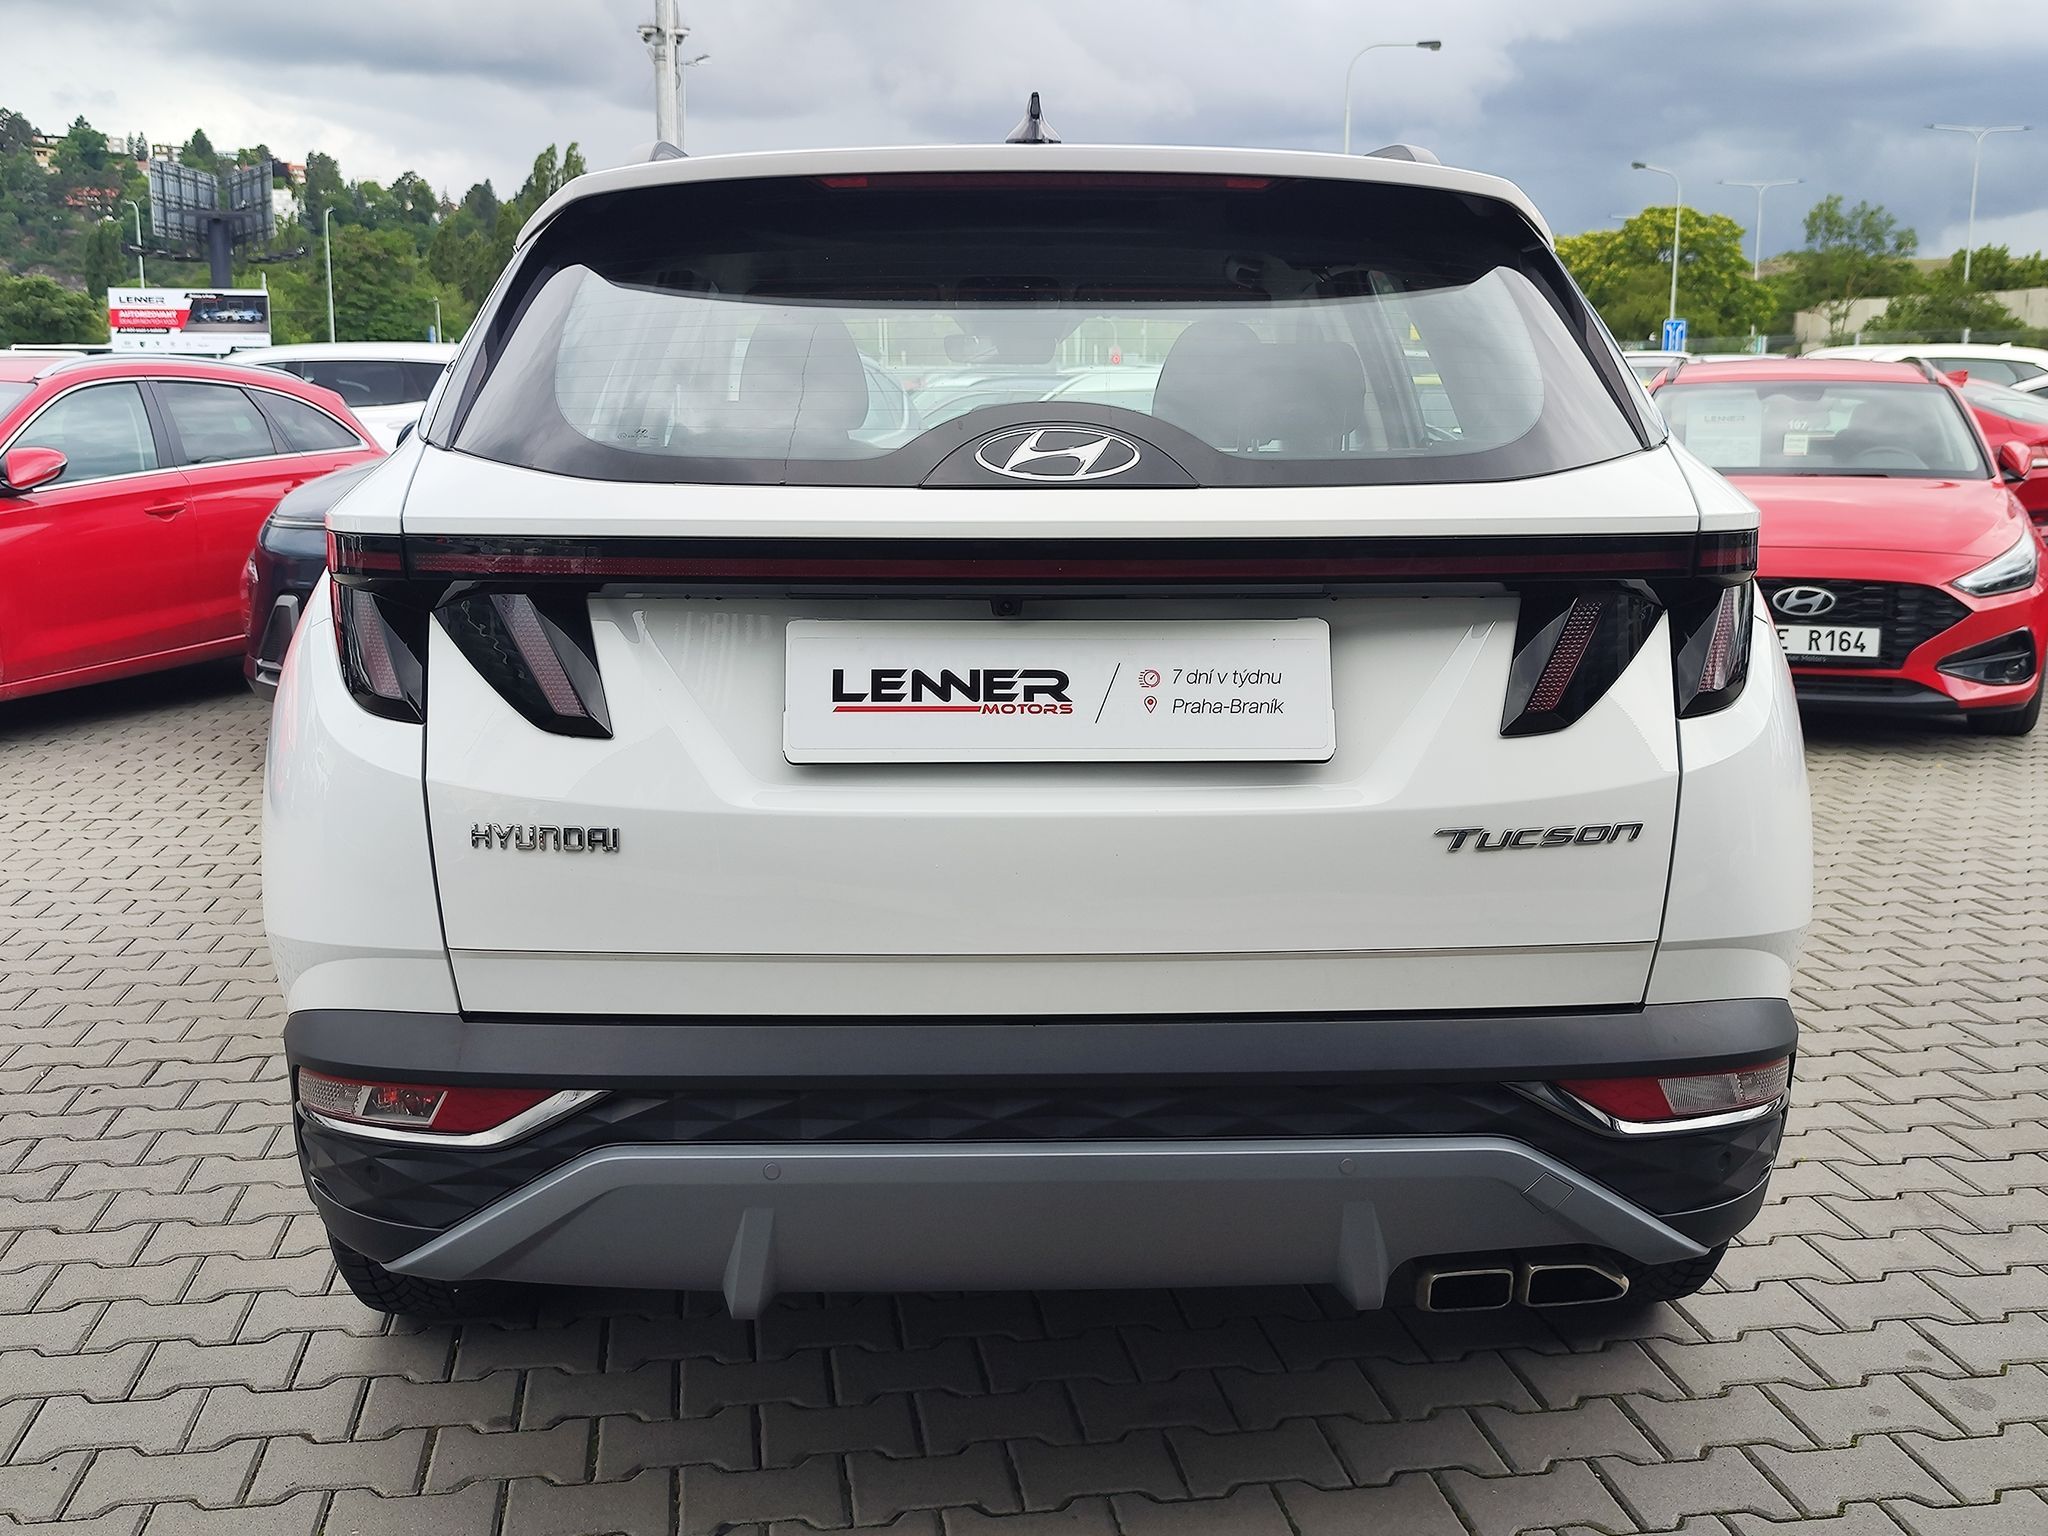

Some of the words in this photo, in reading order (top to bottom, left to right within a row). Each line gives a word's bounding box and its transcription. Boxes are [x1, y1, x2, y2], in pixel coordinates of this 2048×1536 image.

[118, 296, 165, 304] LENNER
[1808, 629, 1867, 653] R164
[832, 669, 1073, 703] LENNER
[1172, 668, 1183, 684] 7
[1186, 668, 1215, 685] dní
[1217, 672, 1228, 685] v
[1232, 669, 1282, 688] týdnu
[981, 703, 1073, 715] MOTORS
[1172, 698, 1285, 714] Praha-Braník
[470, 822, 620, 852] HYUNDAI
